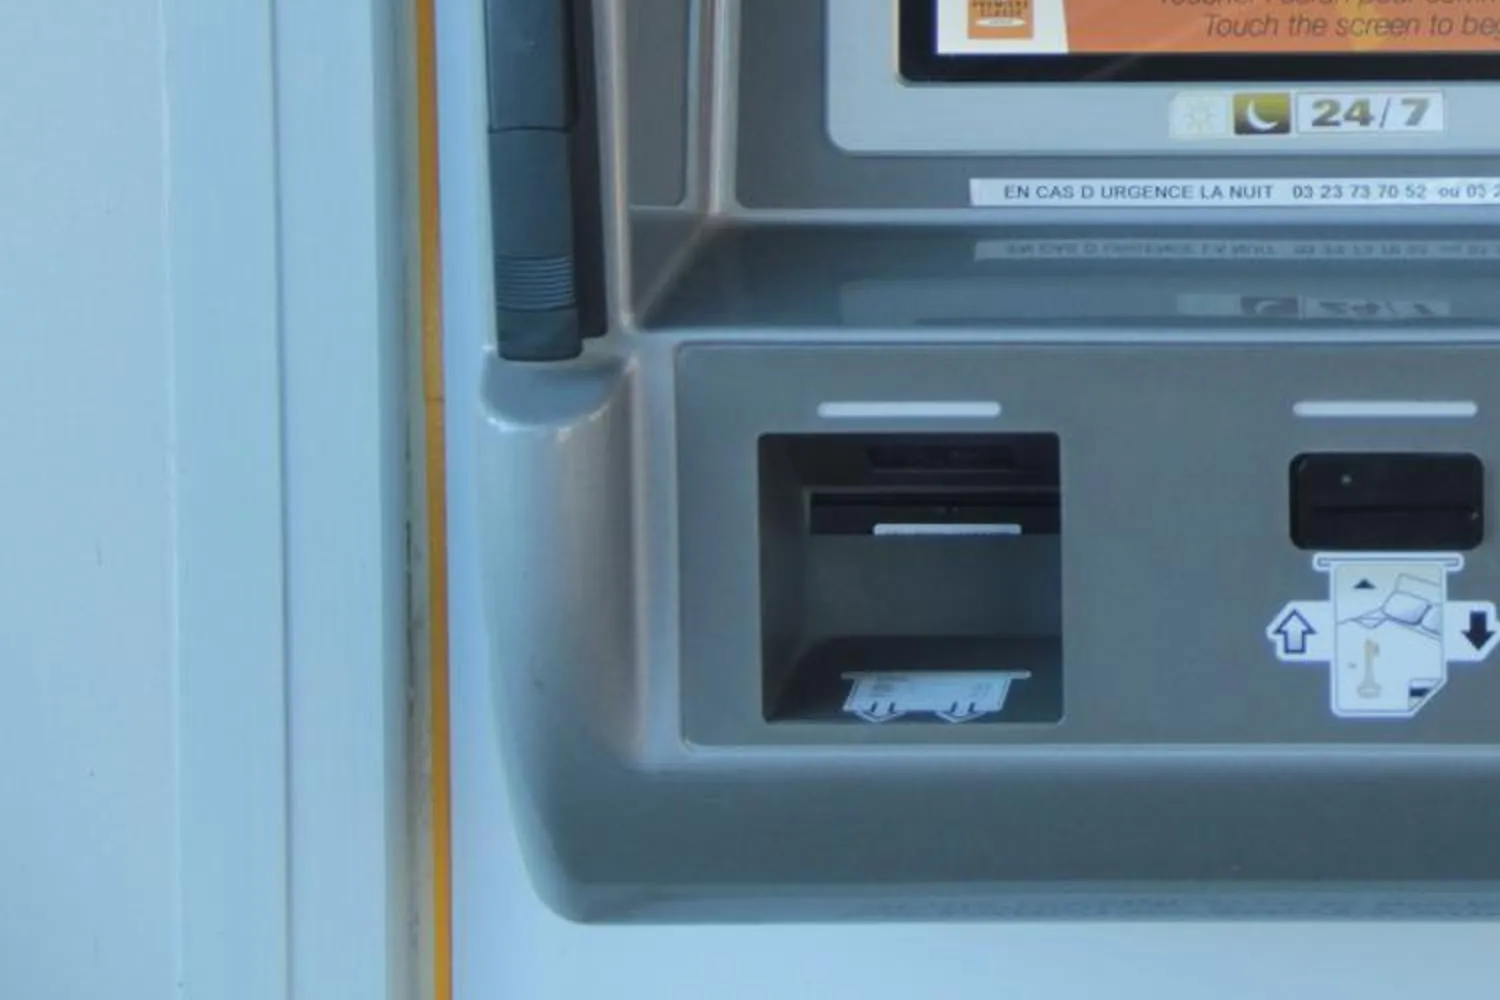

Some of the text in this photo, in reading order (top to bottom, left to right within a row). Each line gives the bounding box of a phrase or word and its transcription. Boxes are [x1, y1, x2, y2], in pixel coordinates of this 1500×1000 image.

[1204, 12, 1278, 38] Touch
[1287, 12, 1329, 37] the
[1335, 15, 1420, 37] screen
[1429, 13, 1454, 37] to
[1308, 97, 1433, 129] 24/7
[1003, 183, 1030, 200] EN
[1035, 183, 1075, 200] CAS
[1080, 183, 1095, 200] D
[1100, 183, 1194, 200] URGENCE
[1199, 183, 1227, 200] LA
[1229, 183, 1275, 200] NUIT
[1292, 183, 1314, 200] 03
[1319, 183, 1344, 200] 23
[1350, 183, 1372, 200] 73
[1377, 183, 1400, 200] 70
[1405, 183, 1427, 199] 52
[1438, 186, 1461, 199] ou
